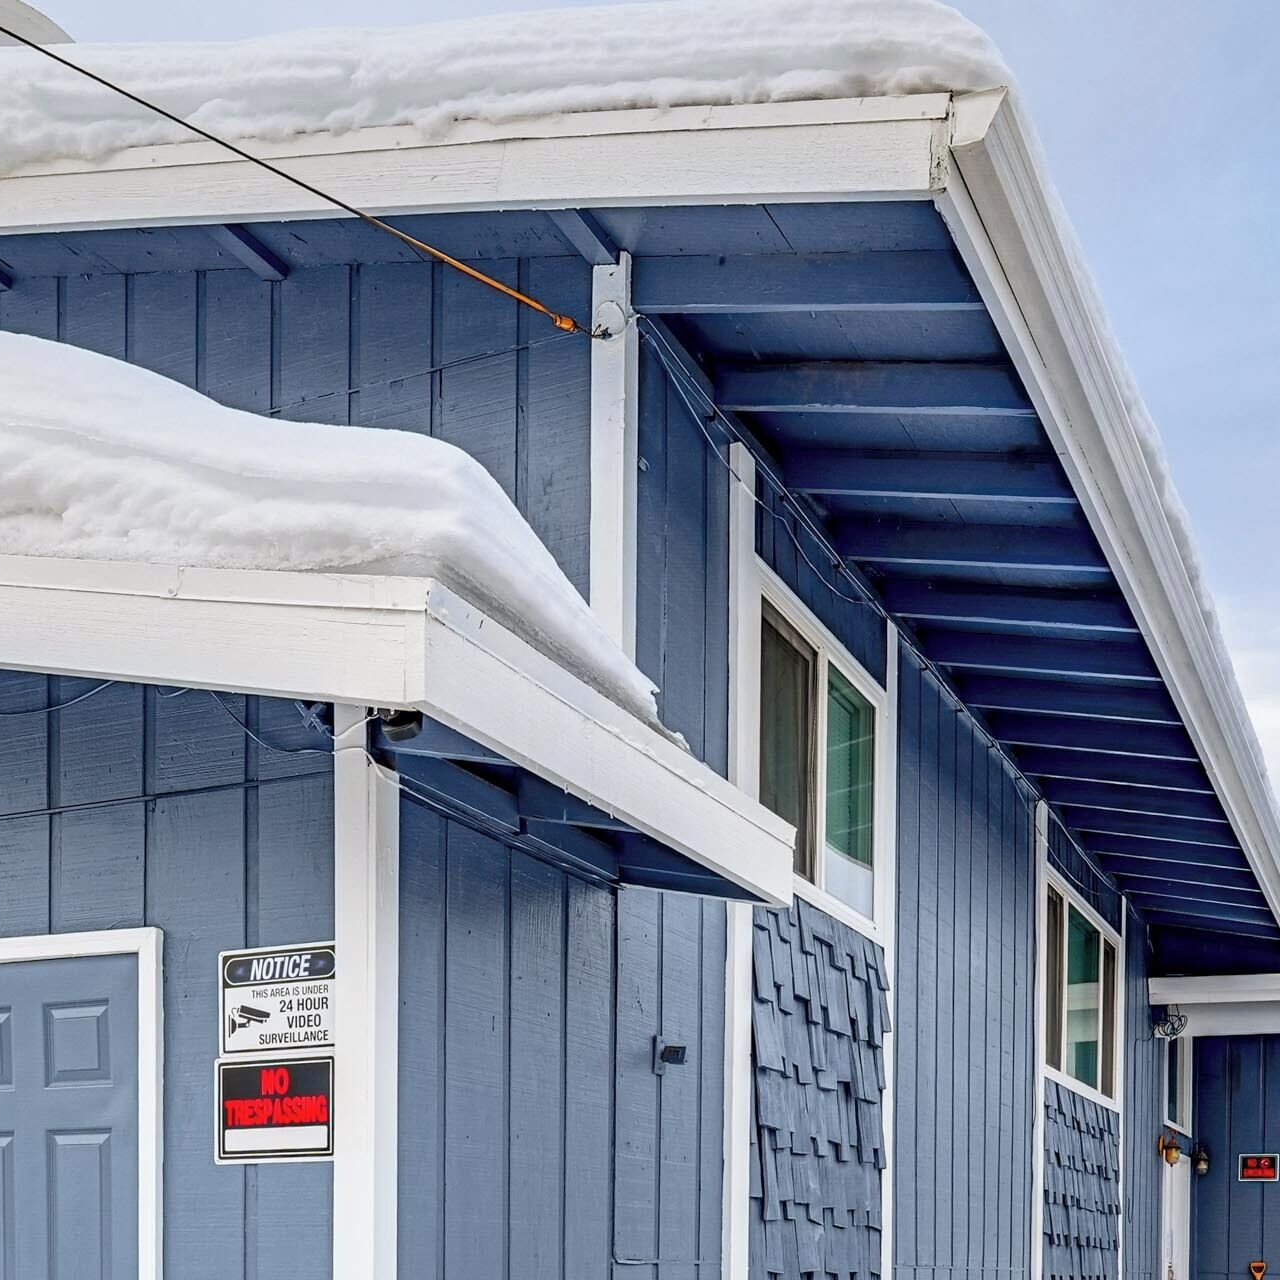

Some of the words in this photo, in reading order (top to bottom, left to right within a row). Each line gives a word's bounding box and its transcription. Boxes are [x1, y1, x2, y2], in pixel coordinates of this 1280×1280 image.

[250, 954, 312, 981] NOTICE
[252, 989, 269, 999] THIS
[270, 987, 290, 998] AREA
[292, 986, 300, 996] IS
[302, 984, 329, 996] UNDER
[279, 999, 293, 1013] 24
[297, 996, 329, 1011] HOUR
[287, 1014, 322, 1029] VIDEO
[259, 1030, 329, 1045] SURVEILLANCE
[260, 1067, 290, 1096] NO
[224, 1094, 328, 1127] TRESPASSING
